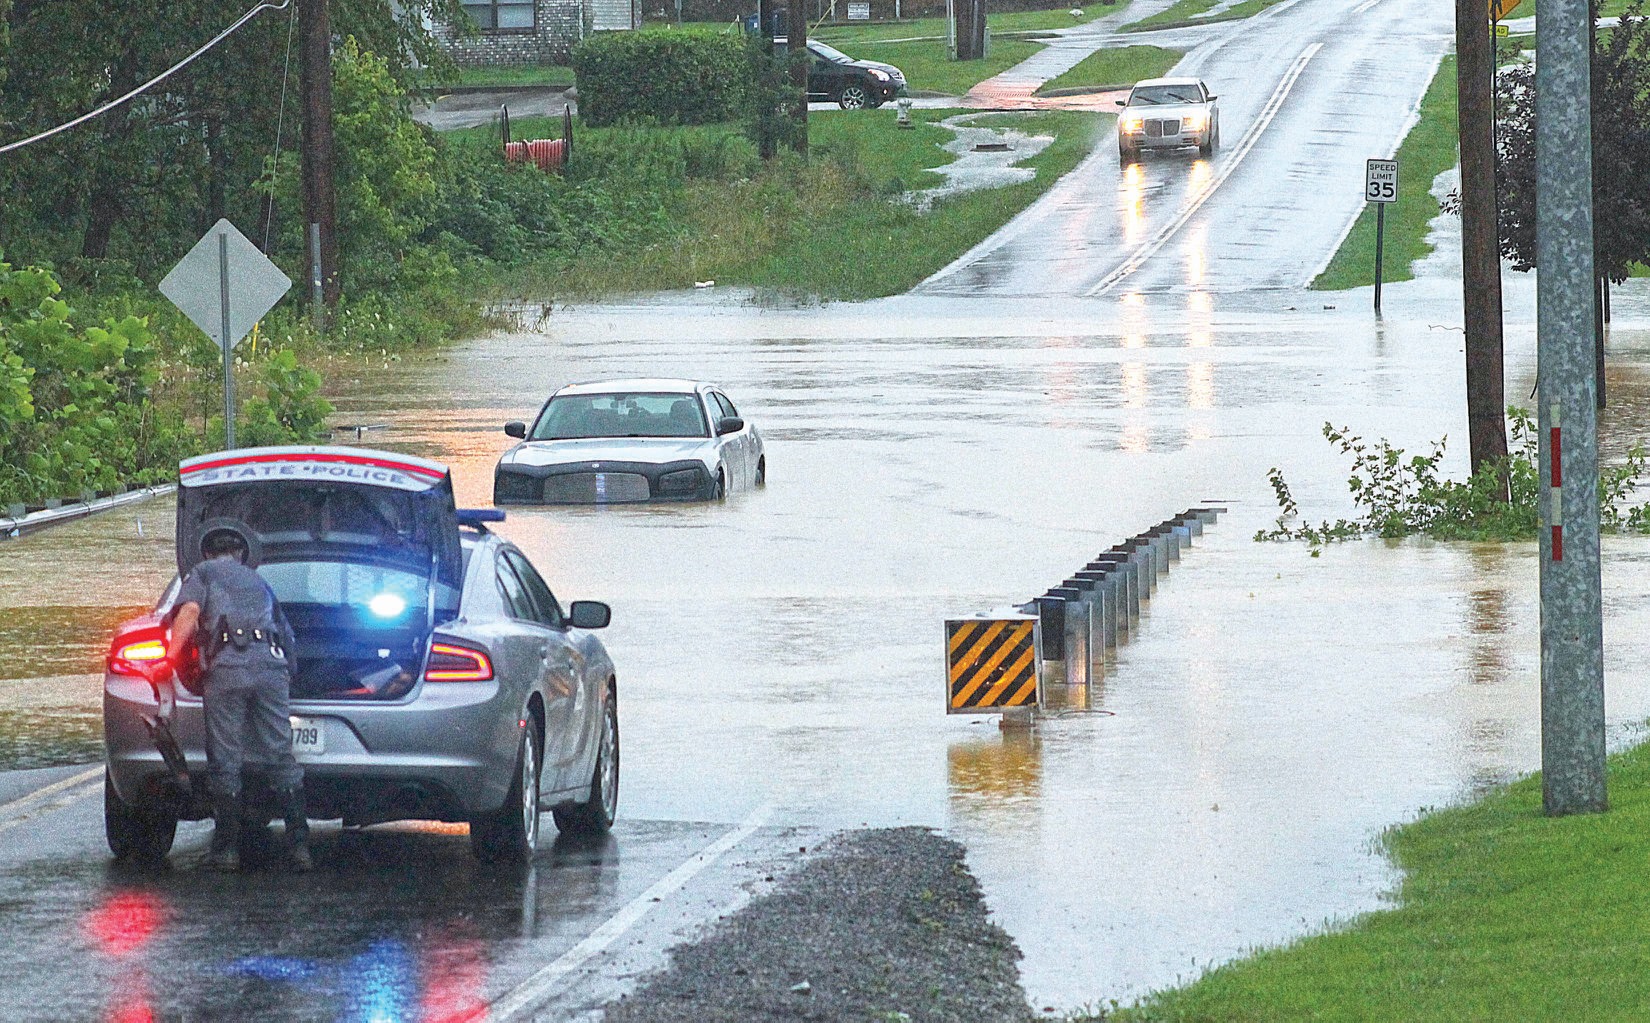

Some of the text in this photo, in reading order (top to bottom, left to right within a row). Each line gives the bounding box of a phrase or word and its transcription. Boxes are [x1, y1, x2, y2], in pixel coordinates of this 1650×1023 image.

[1368, 181, 1394, 198] 35
[202, 464, 403, 484] STATE POLICE
